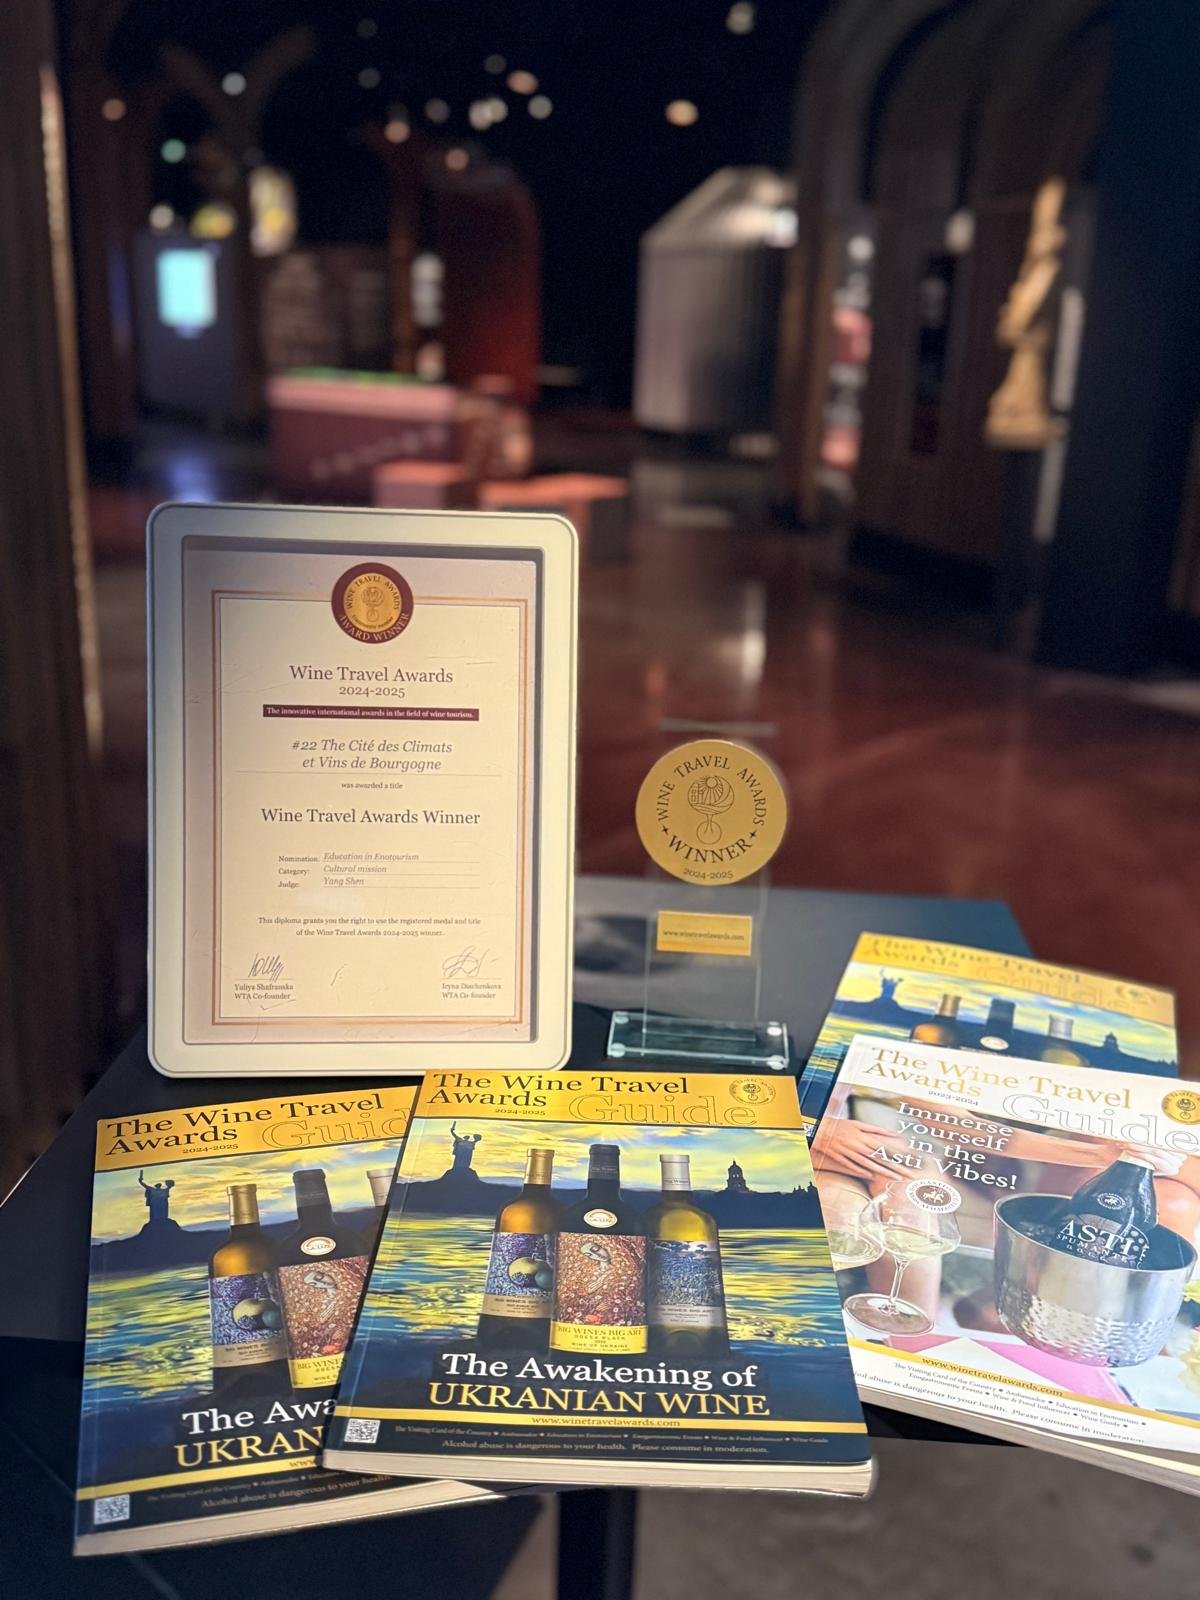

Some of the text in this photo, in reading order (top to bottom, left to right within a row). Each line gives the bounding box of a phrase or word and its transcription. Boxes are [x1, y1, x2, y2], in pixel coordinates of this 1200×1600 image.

[289, 665, 454, 683] Wine Travel Awards
[339, 686, 406, 698] 2024-2025
[266, 707, 280, 715] The
[281, 707, 316, 715] innovative
[317, 708, 361, 716] international
[361, 709, 385, 717] awards
[386, 709, 393, 717] in
[394, 709, 405, 717] the
[406, 709, 421, 717] field
[429, 710, 446, 718] wine
[292, 739, 453, 753] #22 The Cité des Climats
[302, 757, 441, 773] et Vins de Bourgogne
[656, 755, 767, 826] WINE TRAVEL AWARDS
[261, 808, 480, 824] Wine Travel Awards Winner
[323, 852, 420, 862] Education in Enotourism
[668, 834, 753, 864] WINNER
[323, 865, 356, 873] Cultural
[683, 868, 734, 880] 2024-2025
[323, 877, 365, 886] Yang Shen
[274, 917, 301, 925] diploma
[350, 917, 366, 925] right
[234, 983, 255, 992] Yuliya
[252, 992, 290, 1000] Co-founder
[433, 1072, 690, 1094] The Wine Travel
[863, 1062, 983, 1099] Awards
[872, 1047, 928, 1071] The
[935, 1053, 1020, 1089] Wine
[1029, 1074, 1132, 1110] Travel
[426, 1088, 547, 1107] Awards
[107, 1093, 385, 1138] The Wine Travel
[494, 1107, 546, 1117] 2024-2025
[568, 1093, 758, 1127] Guide
[896, 1101, 1015, 1139] Immerse
[1000, 1092, 1200, 1154] Guide
[105, 1125, 238, 1156] Awards
[897, 1119, 1010, 1152] yourself
[182, 1142, 239, 1154] 2024-2025
[909, 1136, 987, 1165] in the
[869, 1145, 1018, 1190] Asti Vibes!
[1060, 1219, 1136, 1256] ASTI
[442, 1353, 759, 1391] The Awakening of
[922, 1357, 1064, 1398] www.winetravelawards.com
[428, 1382, 771, 1417] UKRANIAN WINE
[181, 1407, 255, 1435] The
[531, 1415, 681, 1428] www.winetravelawards.com
